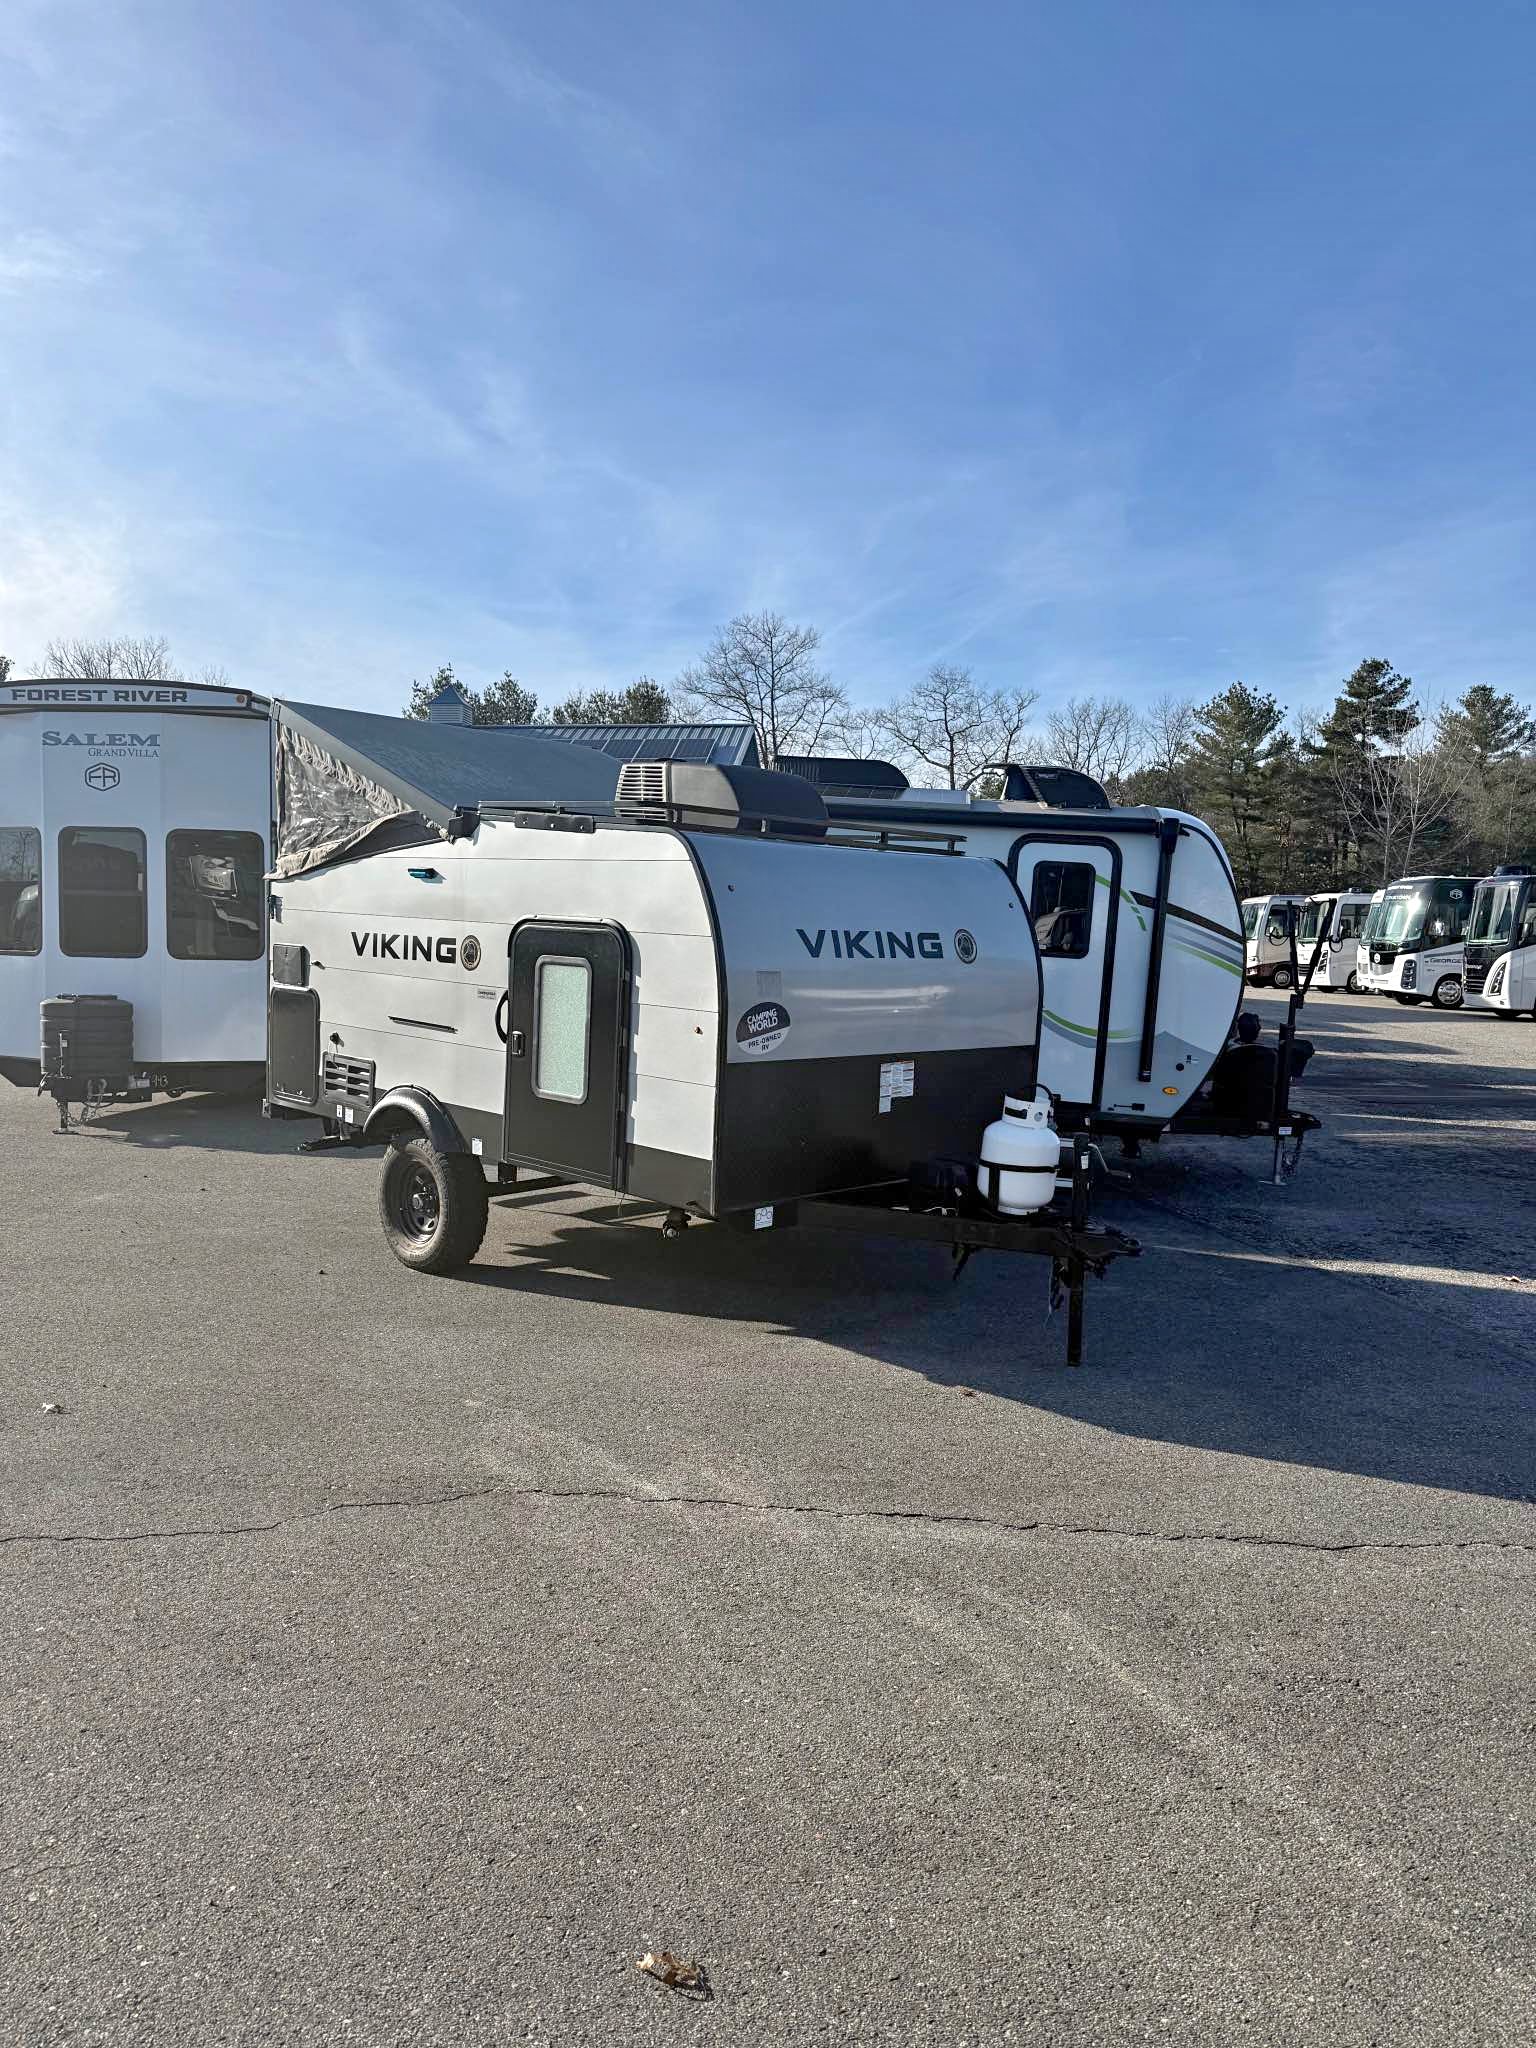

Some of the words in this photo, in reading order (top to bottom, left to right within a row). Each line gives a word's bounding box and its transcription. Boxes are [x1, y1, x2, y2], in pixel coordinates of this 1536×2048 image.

[11, 689, 108, 702] FOREST
[113, 690, 188, 703] RIVER
[41, 731, 160, 747] SALEM
[351, 931, 457, 964] VIKING
[796, 929, 944, 959] VIKING
[747, 1008, 777, 1024] CAMPING
[748, 1016, 778, 1033] WORLD
